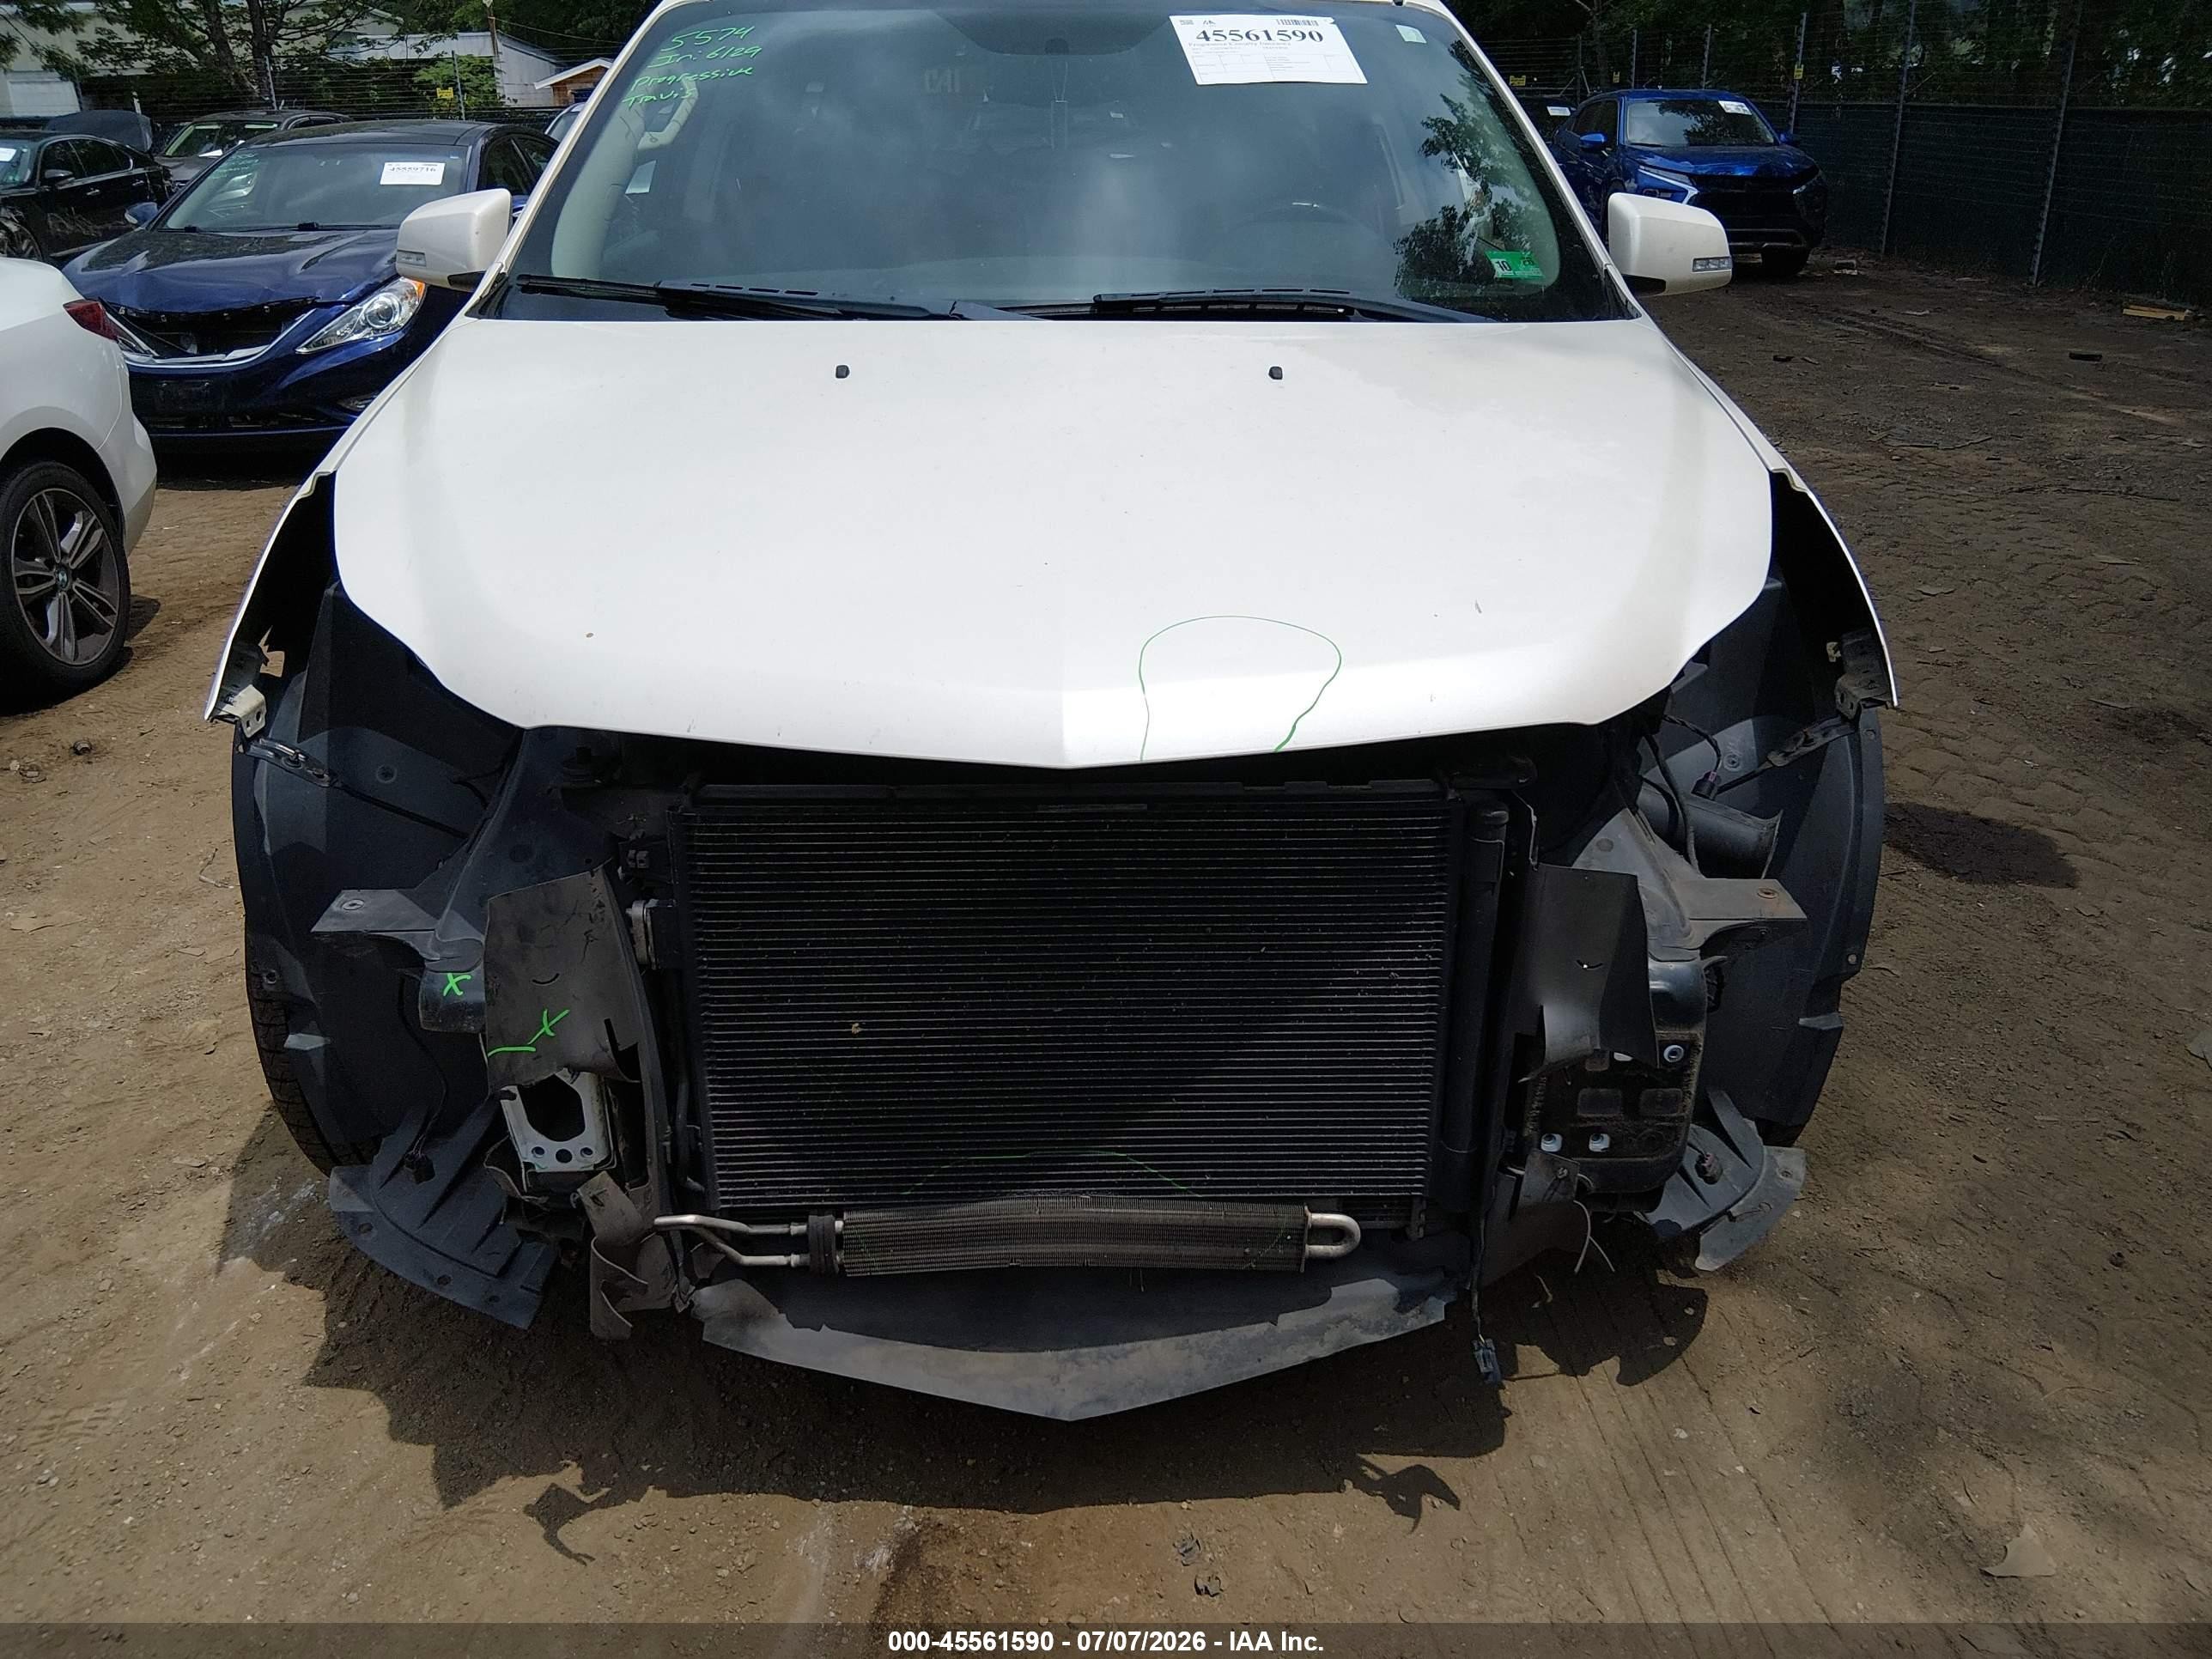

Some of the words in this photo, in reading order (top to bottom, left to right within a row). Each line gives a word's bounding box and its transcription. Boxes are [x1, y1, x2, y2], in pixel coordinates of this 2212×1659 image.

[660, 26, 756, 52] 5574
[1195, 29, 1324, 42] 45561590
[1495, 260, 1512, 271] 10
